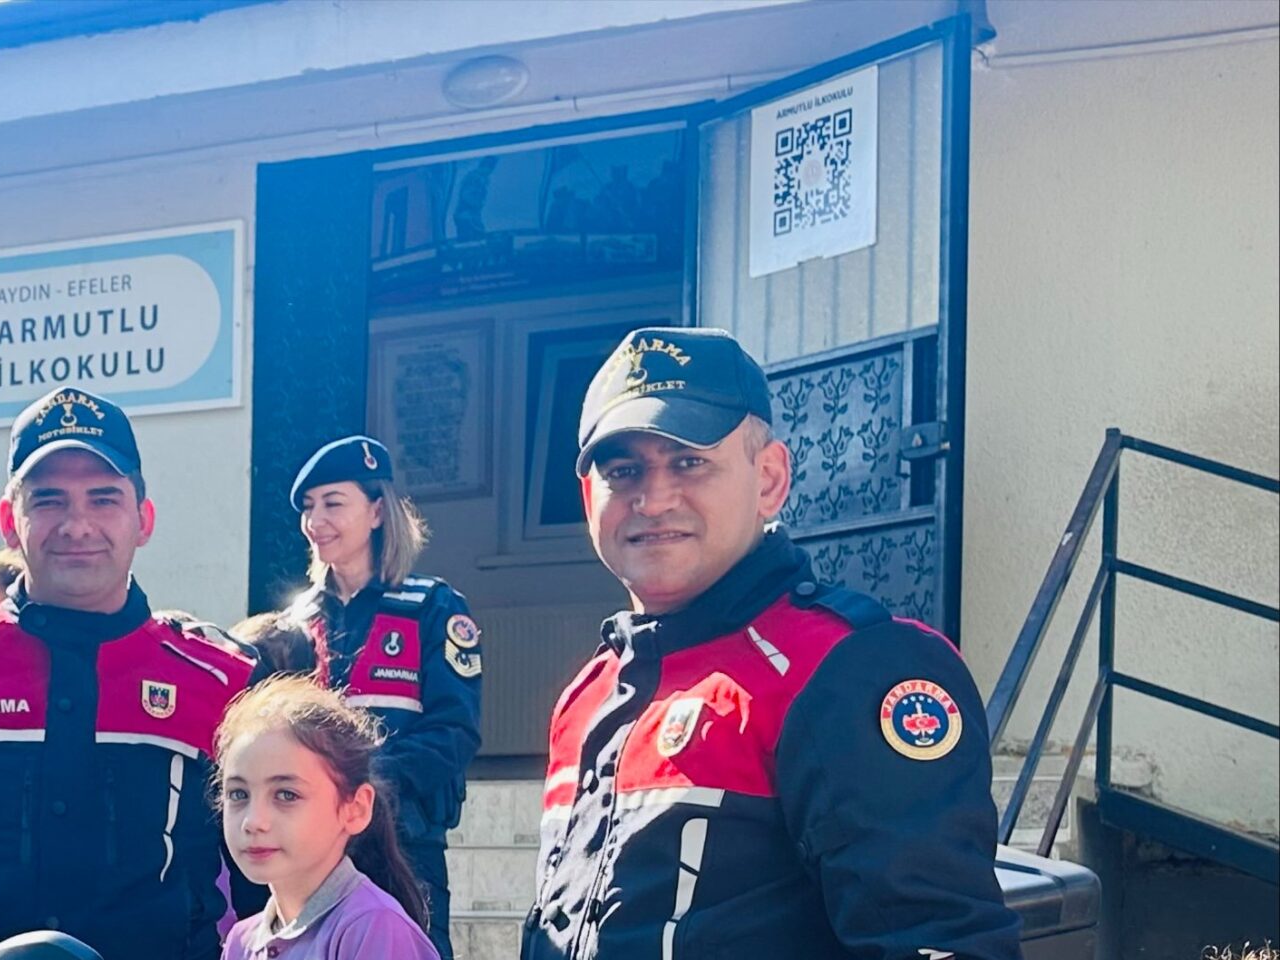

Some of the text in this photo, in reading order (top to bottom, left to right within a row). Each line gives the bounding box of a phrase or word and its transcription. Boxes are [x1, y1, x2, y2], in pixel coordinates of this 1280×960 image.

[776, 86, 854, 119] ARMUTLU İLKOKULU
[67, 274, 132, 298] EFELER
[374, 668, 418, 682] JANDARMA
[884, 681, 957, 713] JANDARMA
